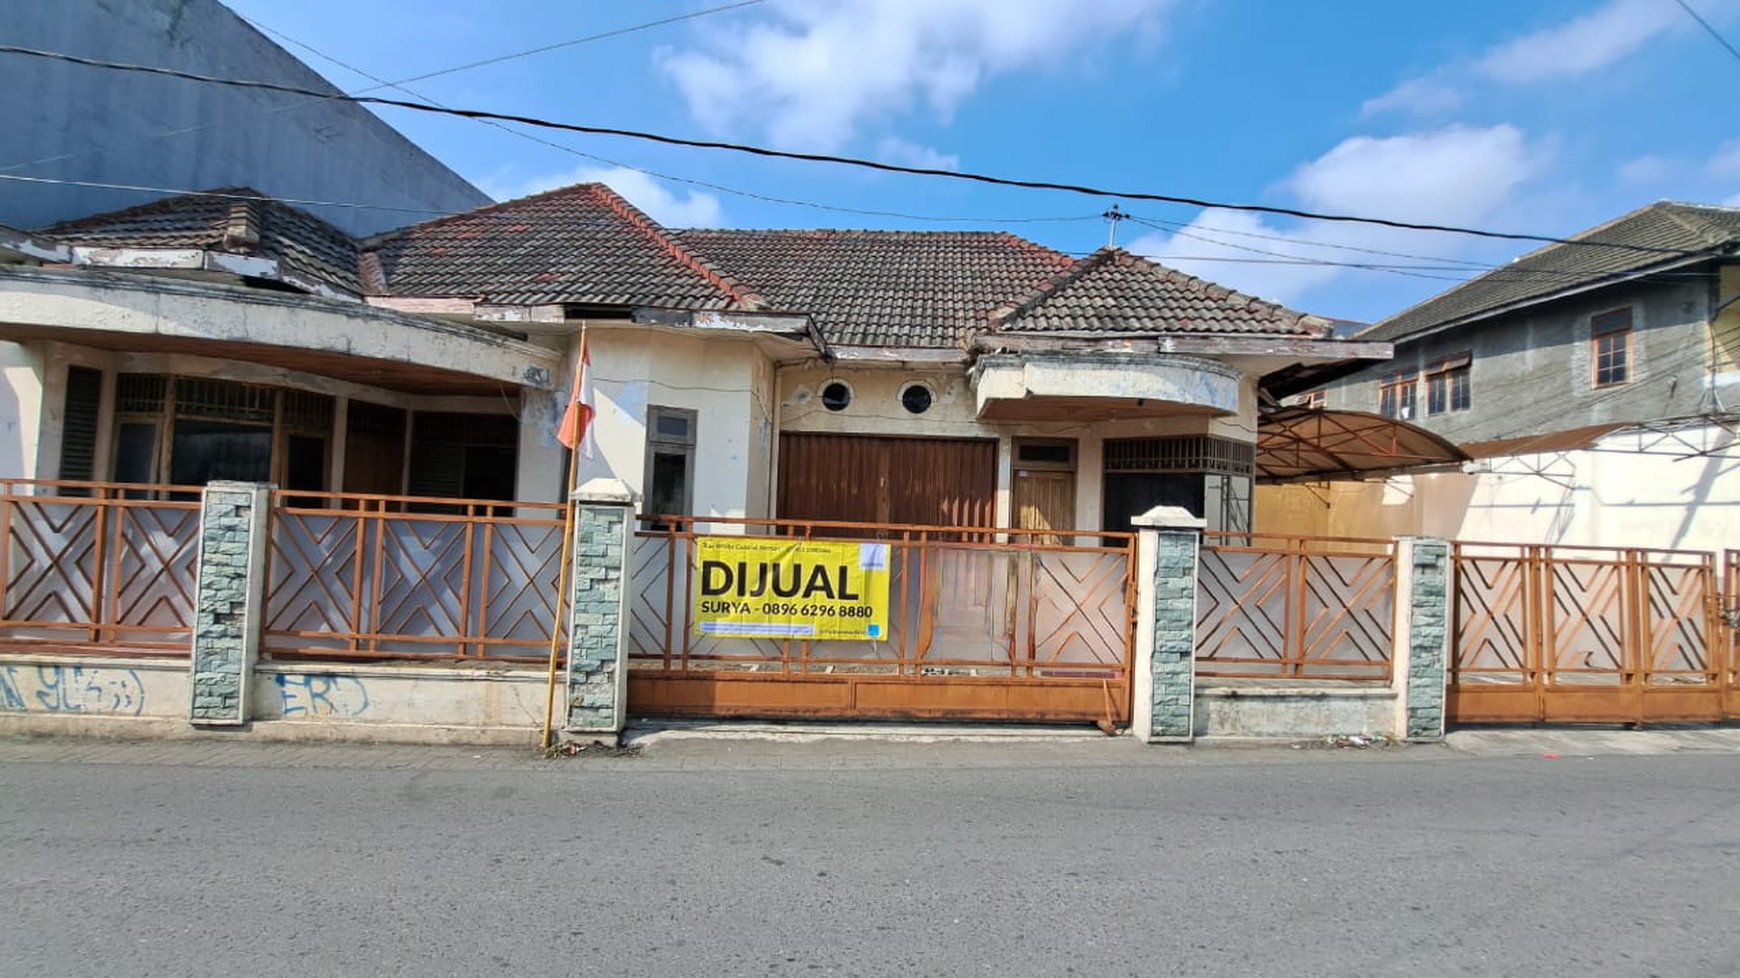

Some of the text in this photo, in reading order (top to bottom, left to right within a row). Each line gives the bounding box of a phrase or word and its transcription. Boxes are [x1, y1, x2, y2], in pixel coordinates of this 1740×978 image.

[701, 560, 859, 600] DIJUAL
[701, 601, 750, 614] SURYA
[762, 603, 798, 616] 0896
[801, 604, 836, 617] 6296
[838, 606, 873, 618] 8880
